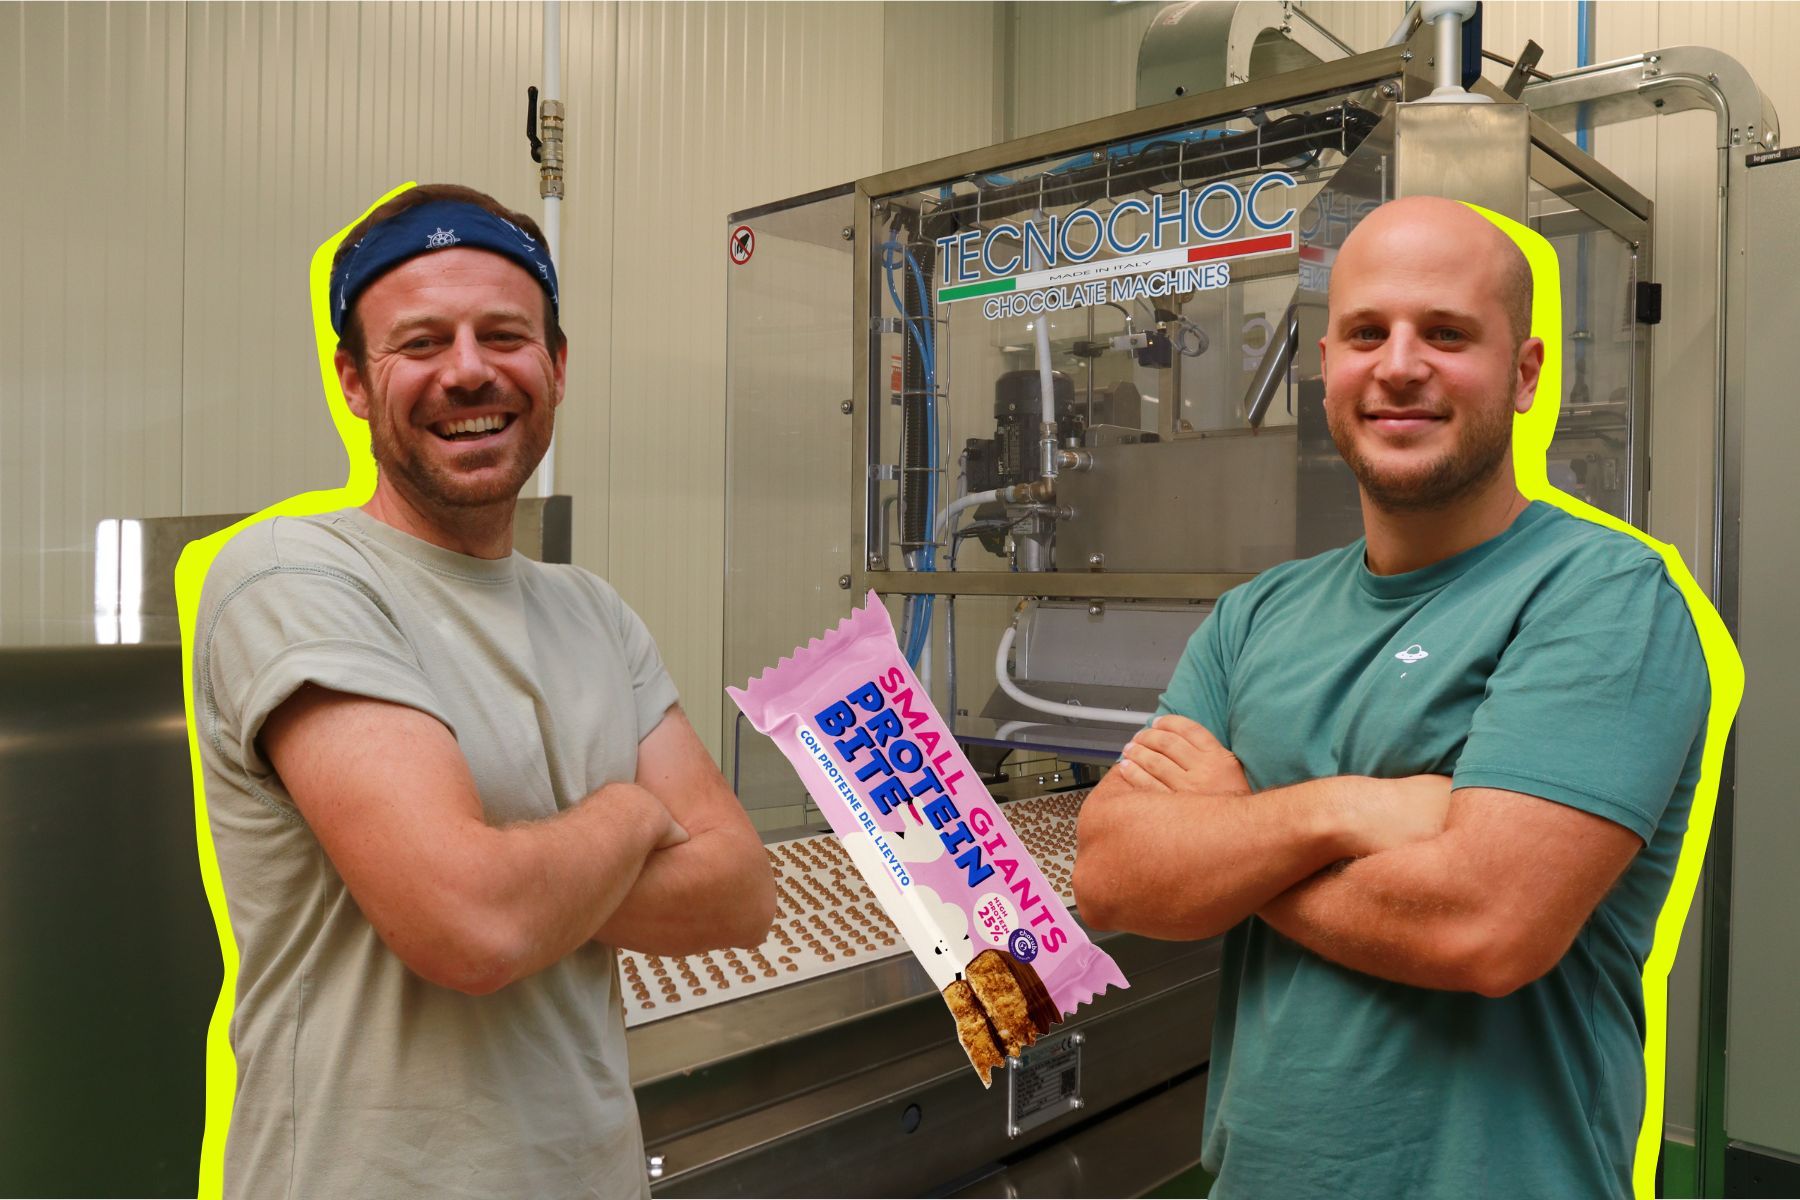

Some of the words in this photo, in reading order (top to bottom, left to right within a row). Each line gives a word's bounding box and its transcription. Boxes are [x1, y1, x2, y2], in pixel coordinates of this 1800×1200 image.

[936, 171, 1297, 284] TECNOCHOC
[984, 280, 1107, 320] CHOCOLATE
[1111, 263, 1231, 301] MACHINES
[1049, 269, 1091, 281] MADE
[1095, 266, 1109, 274] IN
[1114, 260, 1152, 270] ITALY
[814, 700, 911, 816] BITE
[846, 681, 996, 888] PROTEIN
[800, 730, 821, 754] CON
[818, 752, 862, 812] PROTEINE
[858, 811, 878, 836] DEL
[874, 836, 910, 886] LIEVITO
[879, 667, 965, 796] SMALL
[969, 807, 1068, 953] GIANTS
[978, 906, 1004, 942] 25%
[987, 901, 1010, 934] PROTEIN
[993, 896, 1008, 917] HIGH
